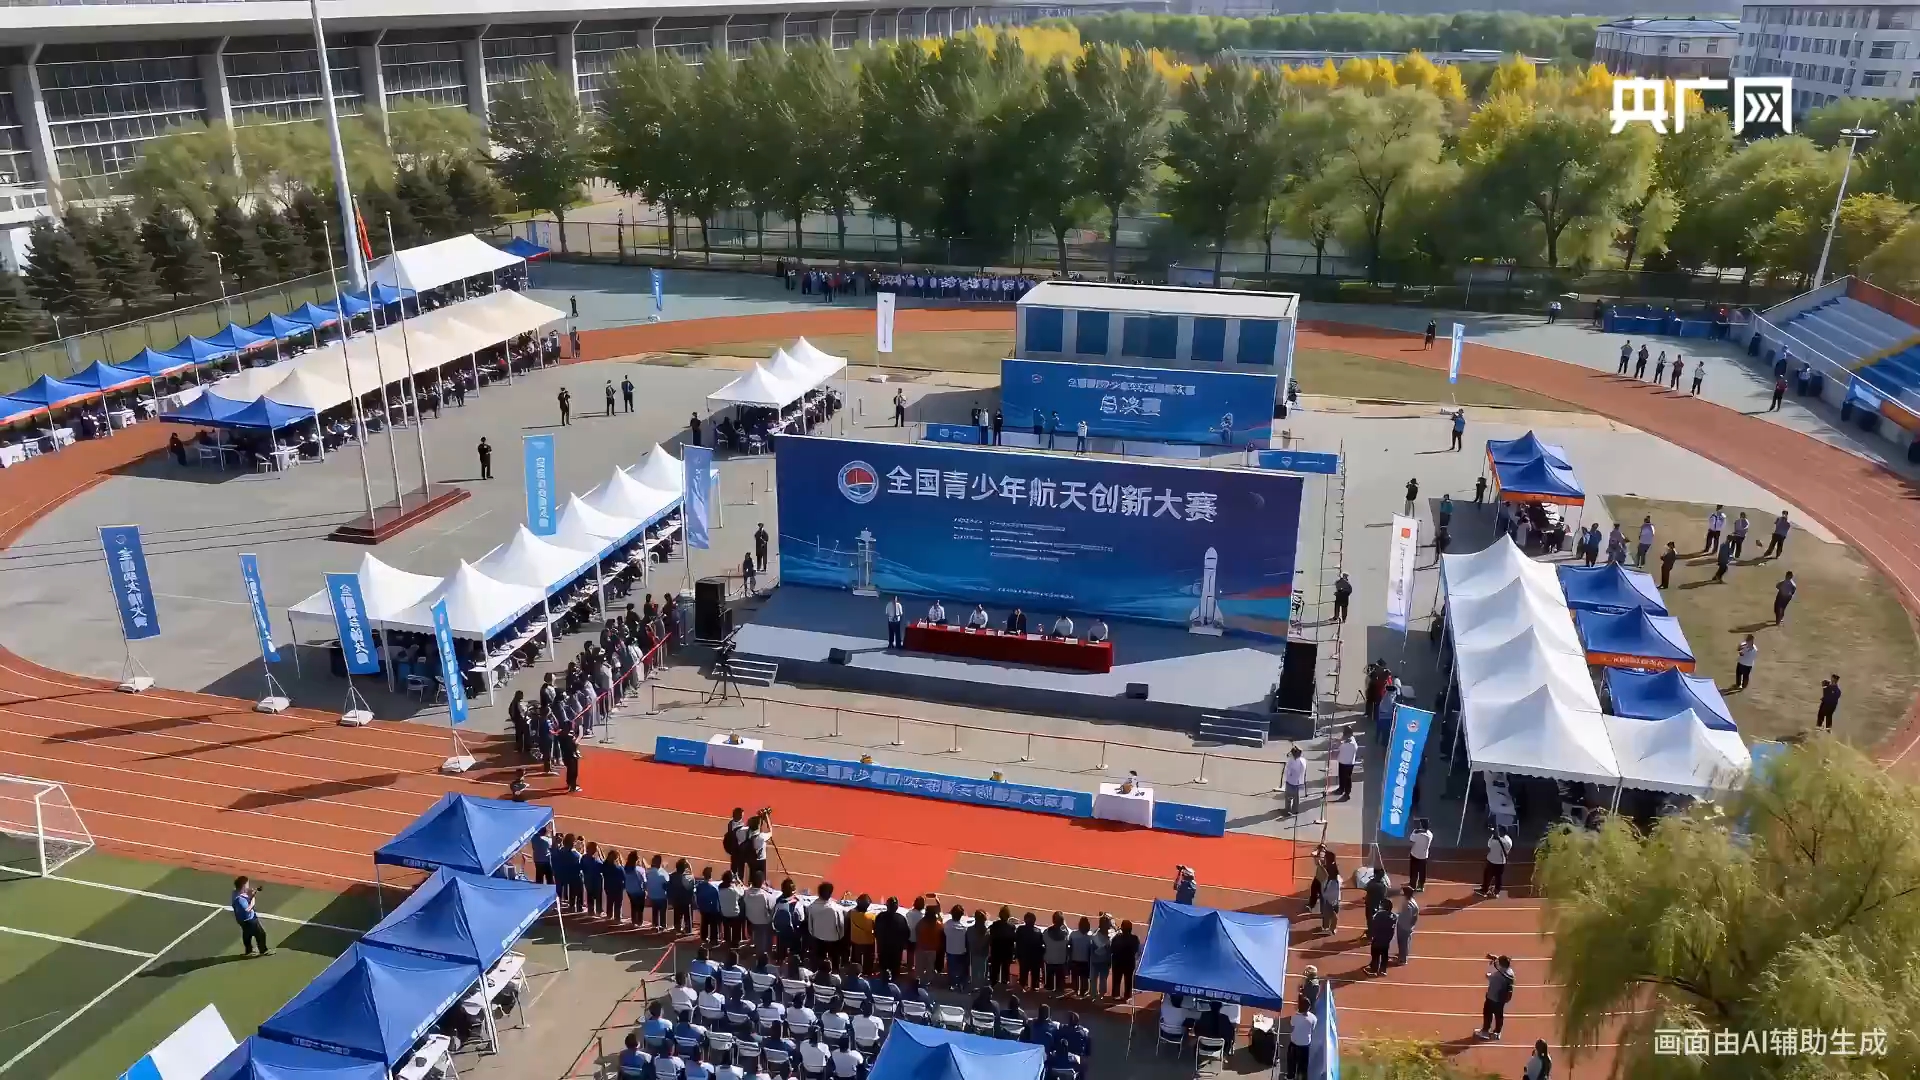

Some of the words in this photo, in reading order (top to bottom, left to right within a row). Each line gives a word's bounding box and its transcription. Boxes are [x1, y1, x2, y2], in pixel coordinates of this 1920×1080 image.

[885, 464, 1219, 523] 全国青少年航天创新大赛
